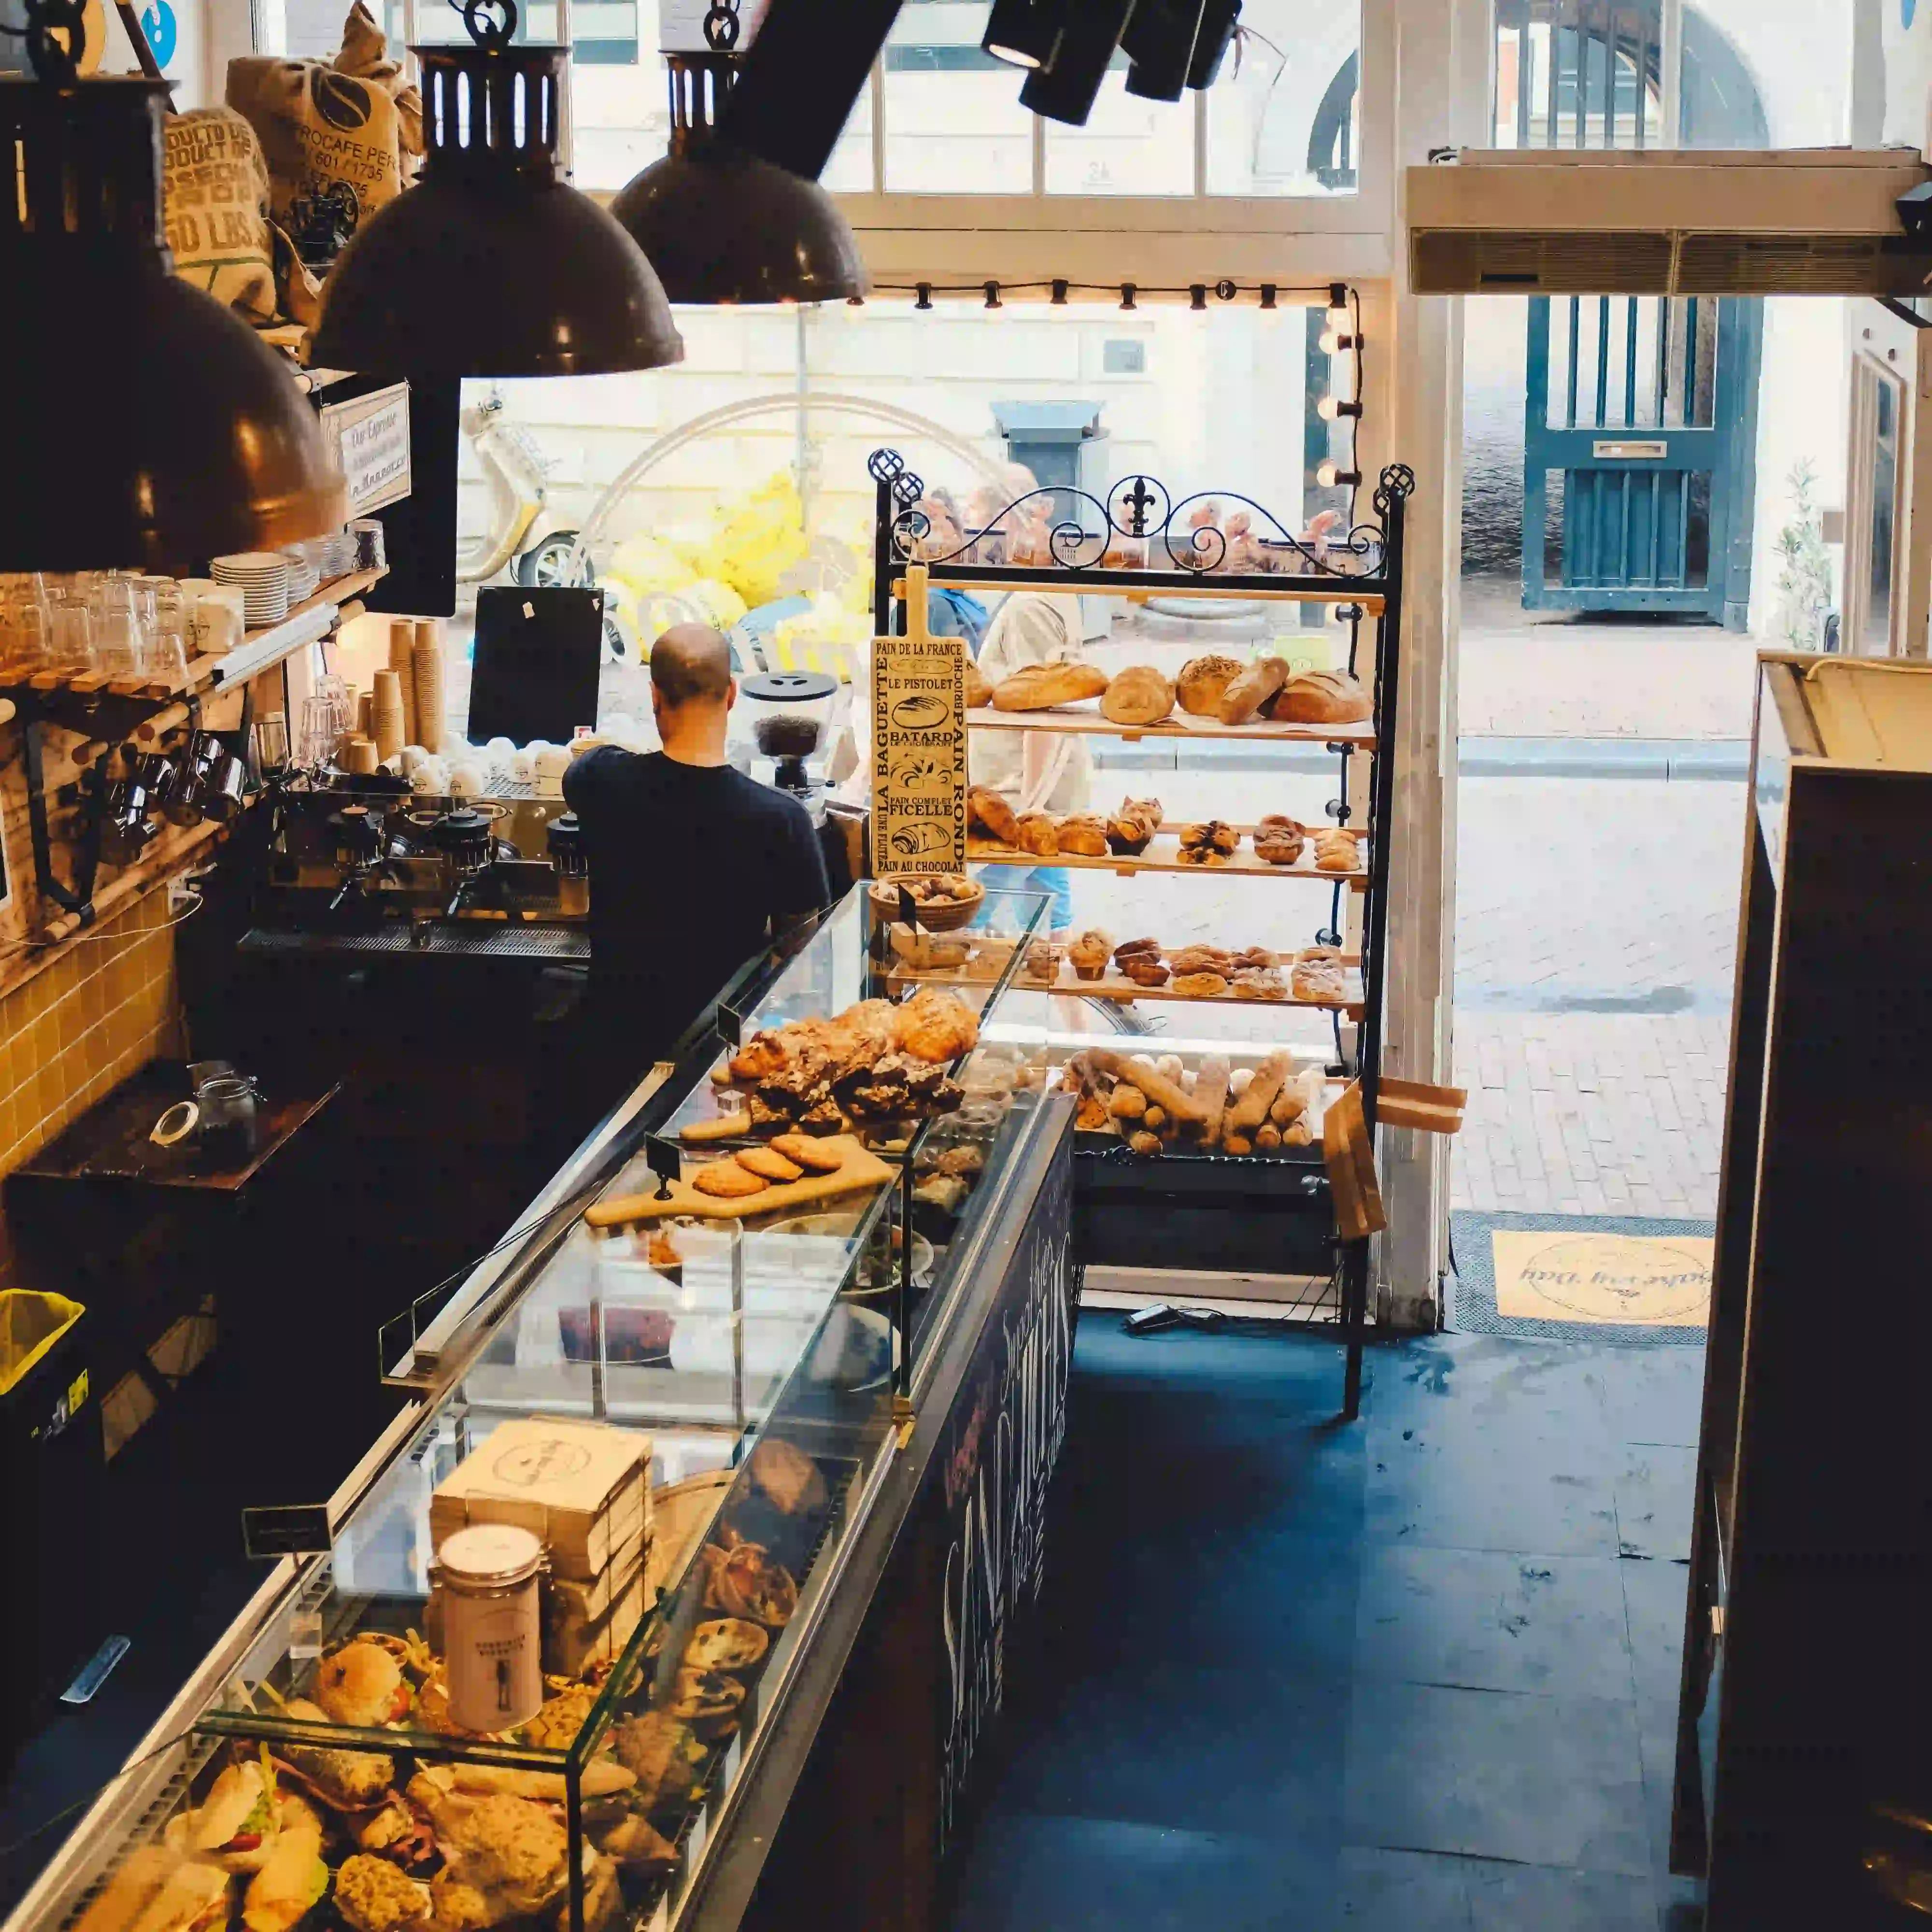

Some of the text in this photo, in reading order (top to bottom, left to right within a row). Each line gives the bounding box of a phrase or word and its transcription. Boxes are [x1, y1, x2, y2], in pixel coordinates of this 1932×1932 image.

[297, 125, 363, 157] ROCAFE
[876, 643, 962, 655] PAIN DE LA FRANCE
[889, 679, 953, 689] LE PISTOLET
[954, 656, 963, 709] BRIOCHE
[877, 656, 889, 812] LA BAGUETTE
[890, 732, 953, 741] BATARD
[953, 711, 965, 861] PAIN ROND
[890, 804, 953, 816] FICELLE
[878, 861, 964, 872] PAIN AU CHOCOLAT
